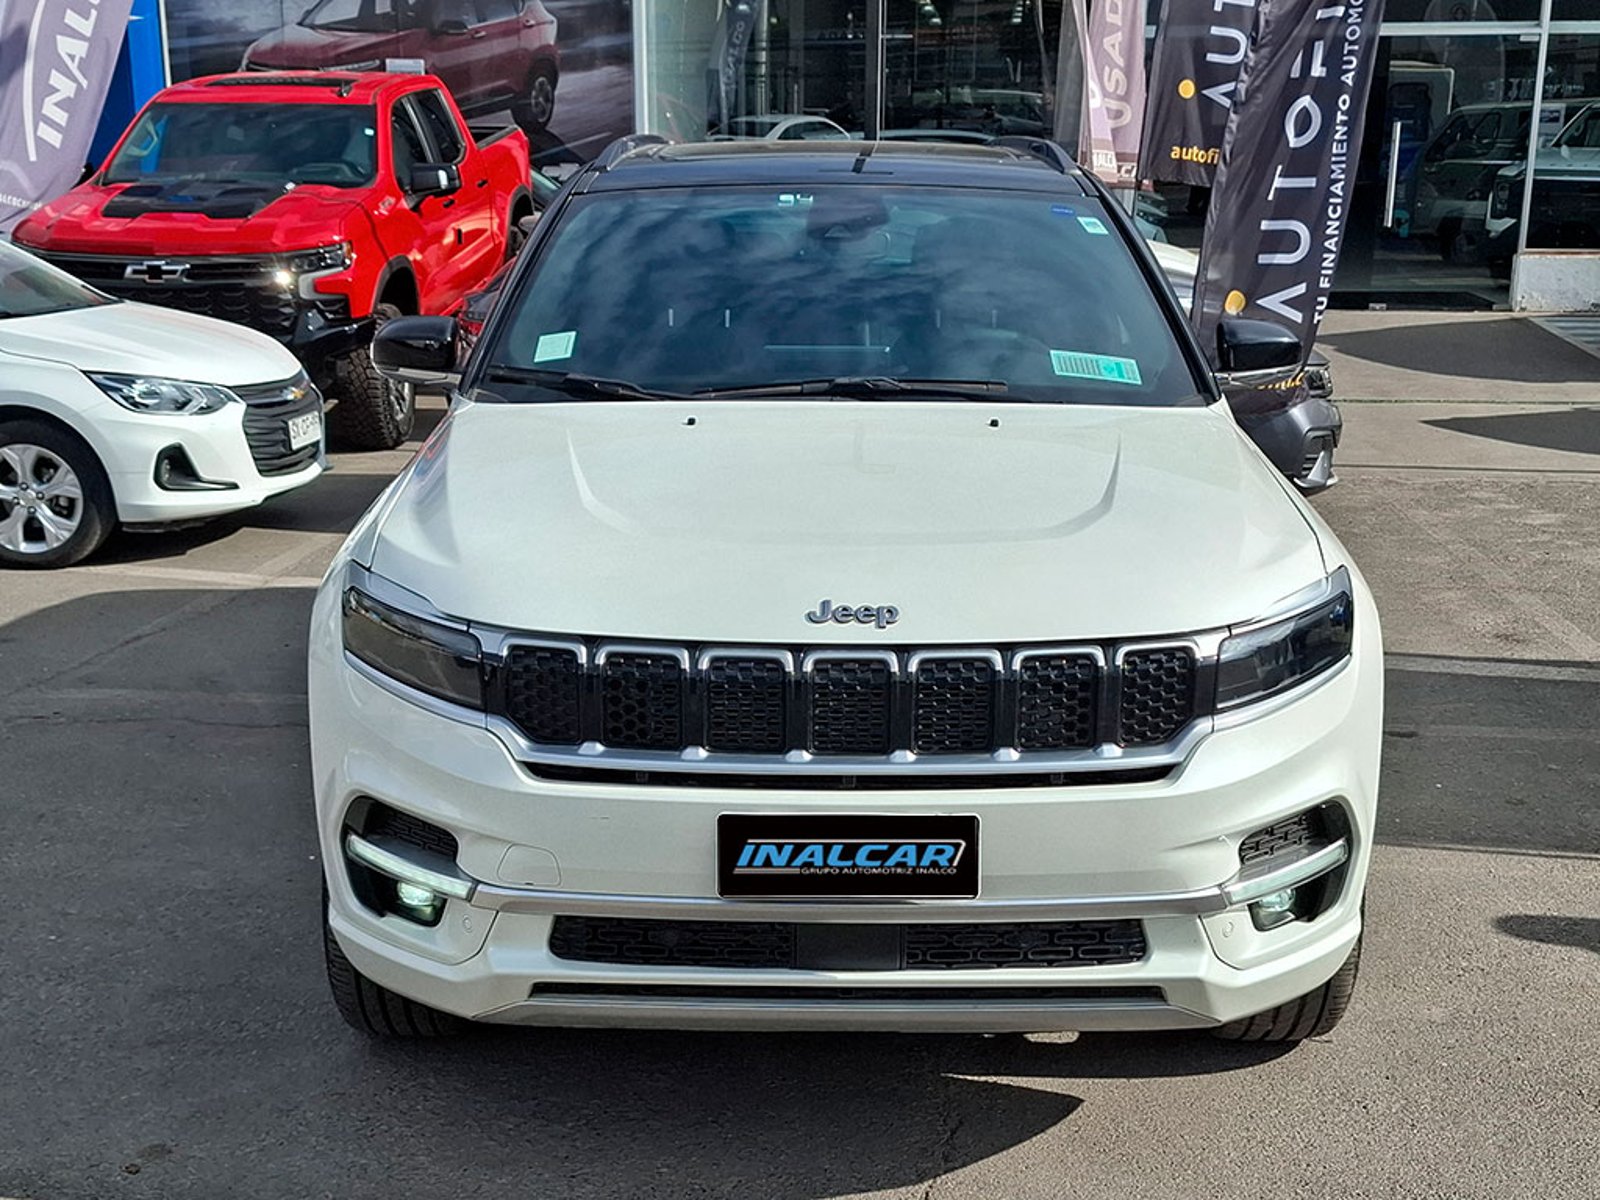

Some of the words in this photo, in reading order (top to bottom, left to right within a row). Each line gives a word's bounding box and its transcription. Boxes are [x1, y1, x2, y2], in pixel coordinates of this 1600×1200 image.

[36, 0, 100, 149] INAL
[1318, 94, 1351, 289] FINANCIAMIENTO
[1313, 296, 1328, 325] TU
[804, 599, 899, 629] Jeep
[736, 844, 955, 867] INALCAR
[801, 867, 840, 875] GRUPO
[842, 867, 913, 875] AUTOMOTRIZ
[915, 867, 957, 875] INALCO
